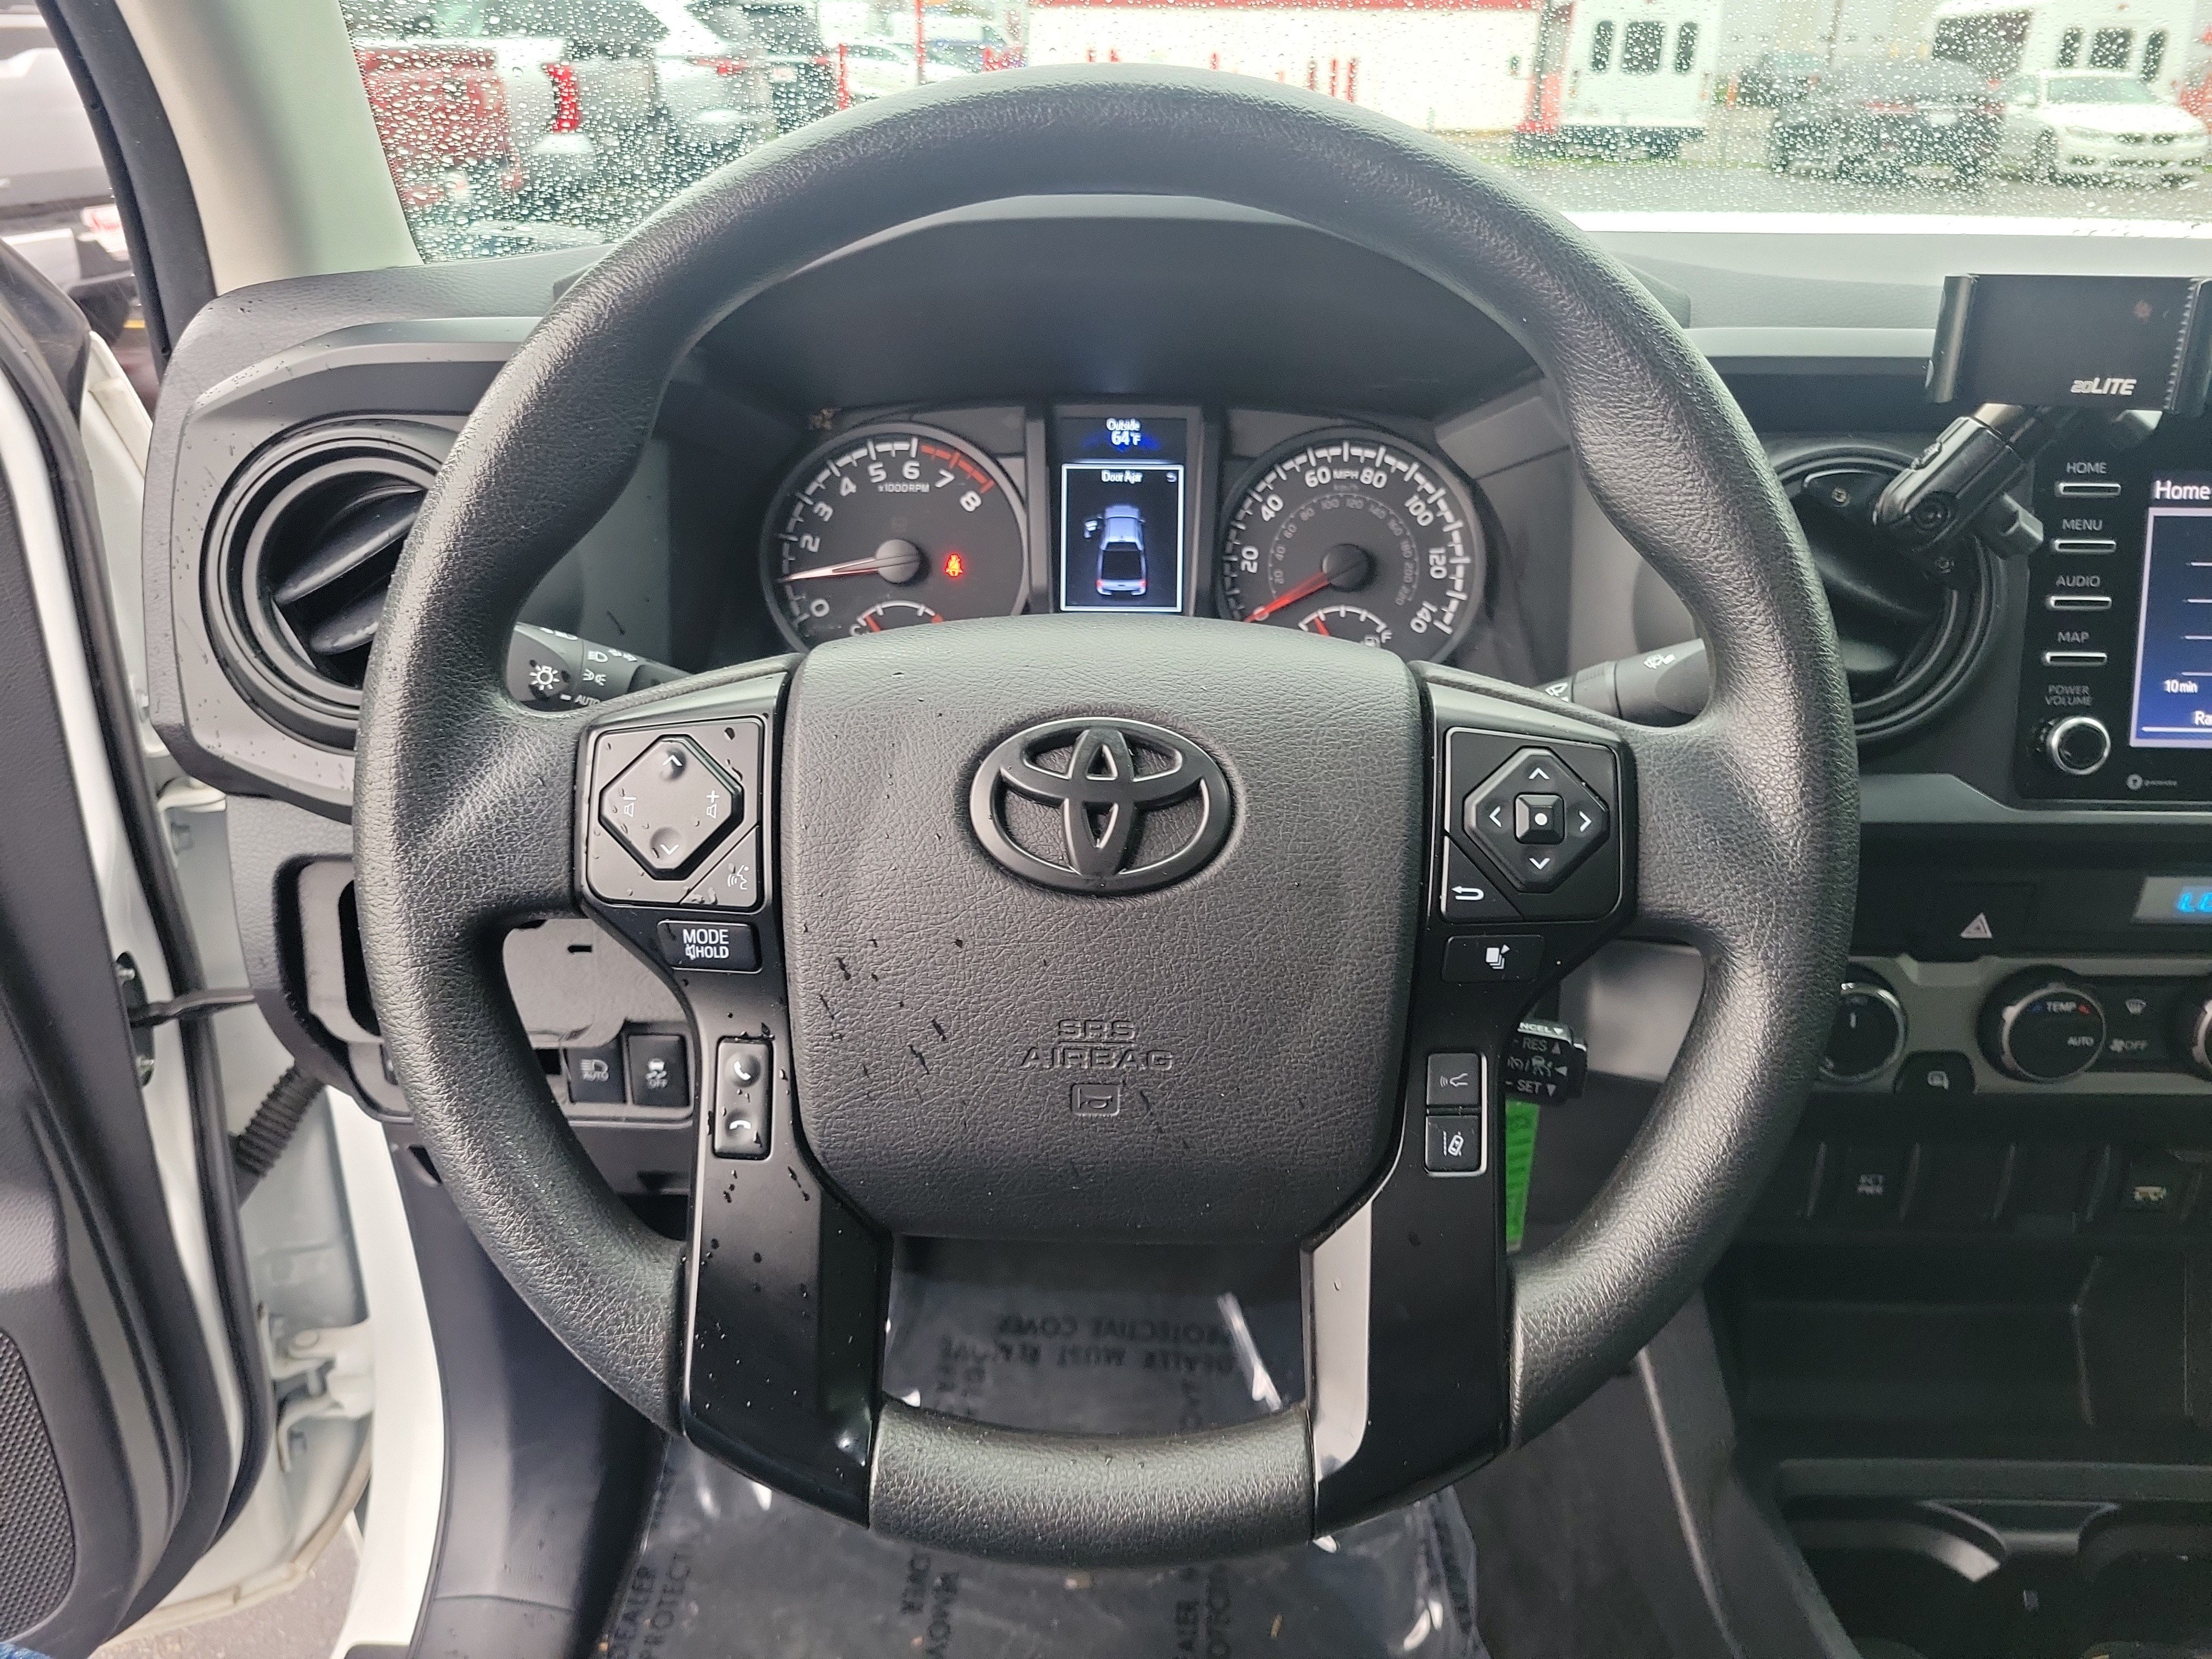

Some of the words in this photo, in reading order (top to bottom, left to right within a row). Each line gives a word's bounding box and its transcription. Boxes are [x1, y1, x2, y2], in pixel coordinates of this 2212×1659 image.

[1106, 417, 1141, 431] Outside
[868, 461, 887, 483] 5
[902, 460, 920, 480] 6
[1333, 469, 1359, 480] MPH
[2067, 462, 2108, 474] HOME
[935, 468, 955, 488] 7
[1101, 470, 1124, 482] Door
[1125, 470, 1143, 484] Ajar
[1304, 466, 1331, 488] 60
[1359, 467, 1387, 488] 80
[839, 476, 857, 496] 4
[2154, 479, 2211, 500] Home
[960, 490, 983, 512] 8
[1261, 493, 1284, 522] 40
[812, 500, 834, 522] 3
[1404, 494, 1435, 527] 100
[2062, 518, 2103, 531] MENU
[800, 533, 821, 552] 2
[1241, 545, 1259, 573] 20
[1429, 547, 1448, 579] 120
[2056, 575, 2101, 588] AUDIO
[810, 597, 830, 618] 0
[1410, 601, 1438, 634] 140
[1381, 629, 1392, 644] F
[2057, 631, 2090, 643] MAP
[2048, 684, 2090, 696] POWER
[2044, 696, 2094, 706] VOLUME
[682, 928, 730, 944] MODE
[695, 945, 729, 958] HOLD
[2047, 1001, 2077, 1013] TEMP
[1058, 1019, 1136, 1041] SRS
[1522, 1037, 1548, 1052] RES
[2067, 1036, 2095, 1047] AUTO
[2125, 1040, 2148, 1051] OFF
[1022, 1046, 1173, 1072] AIRBAG
[583, 1072, 609, 1082] AUTO
[646, 1079, 668, 1090] OFF
[1517, 1079, 1543, 1094] SET
